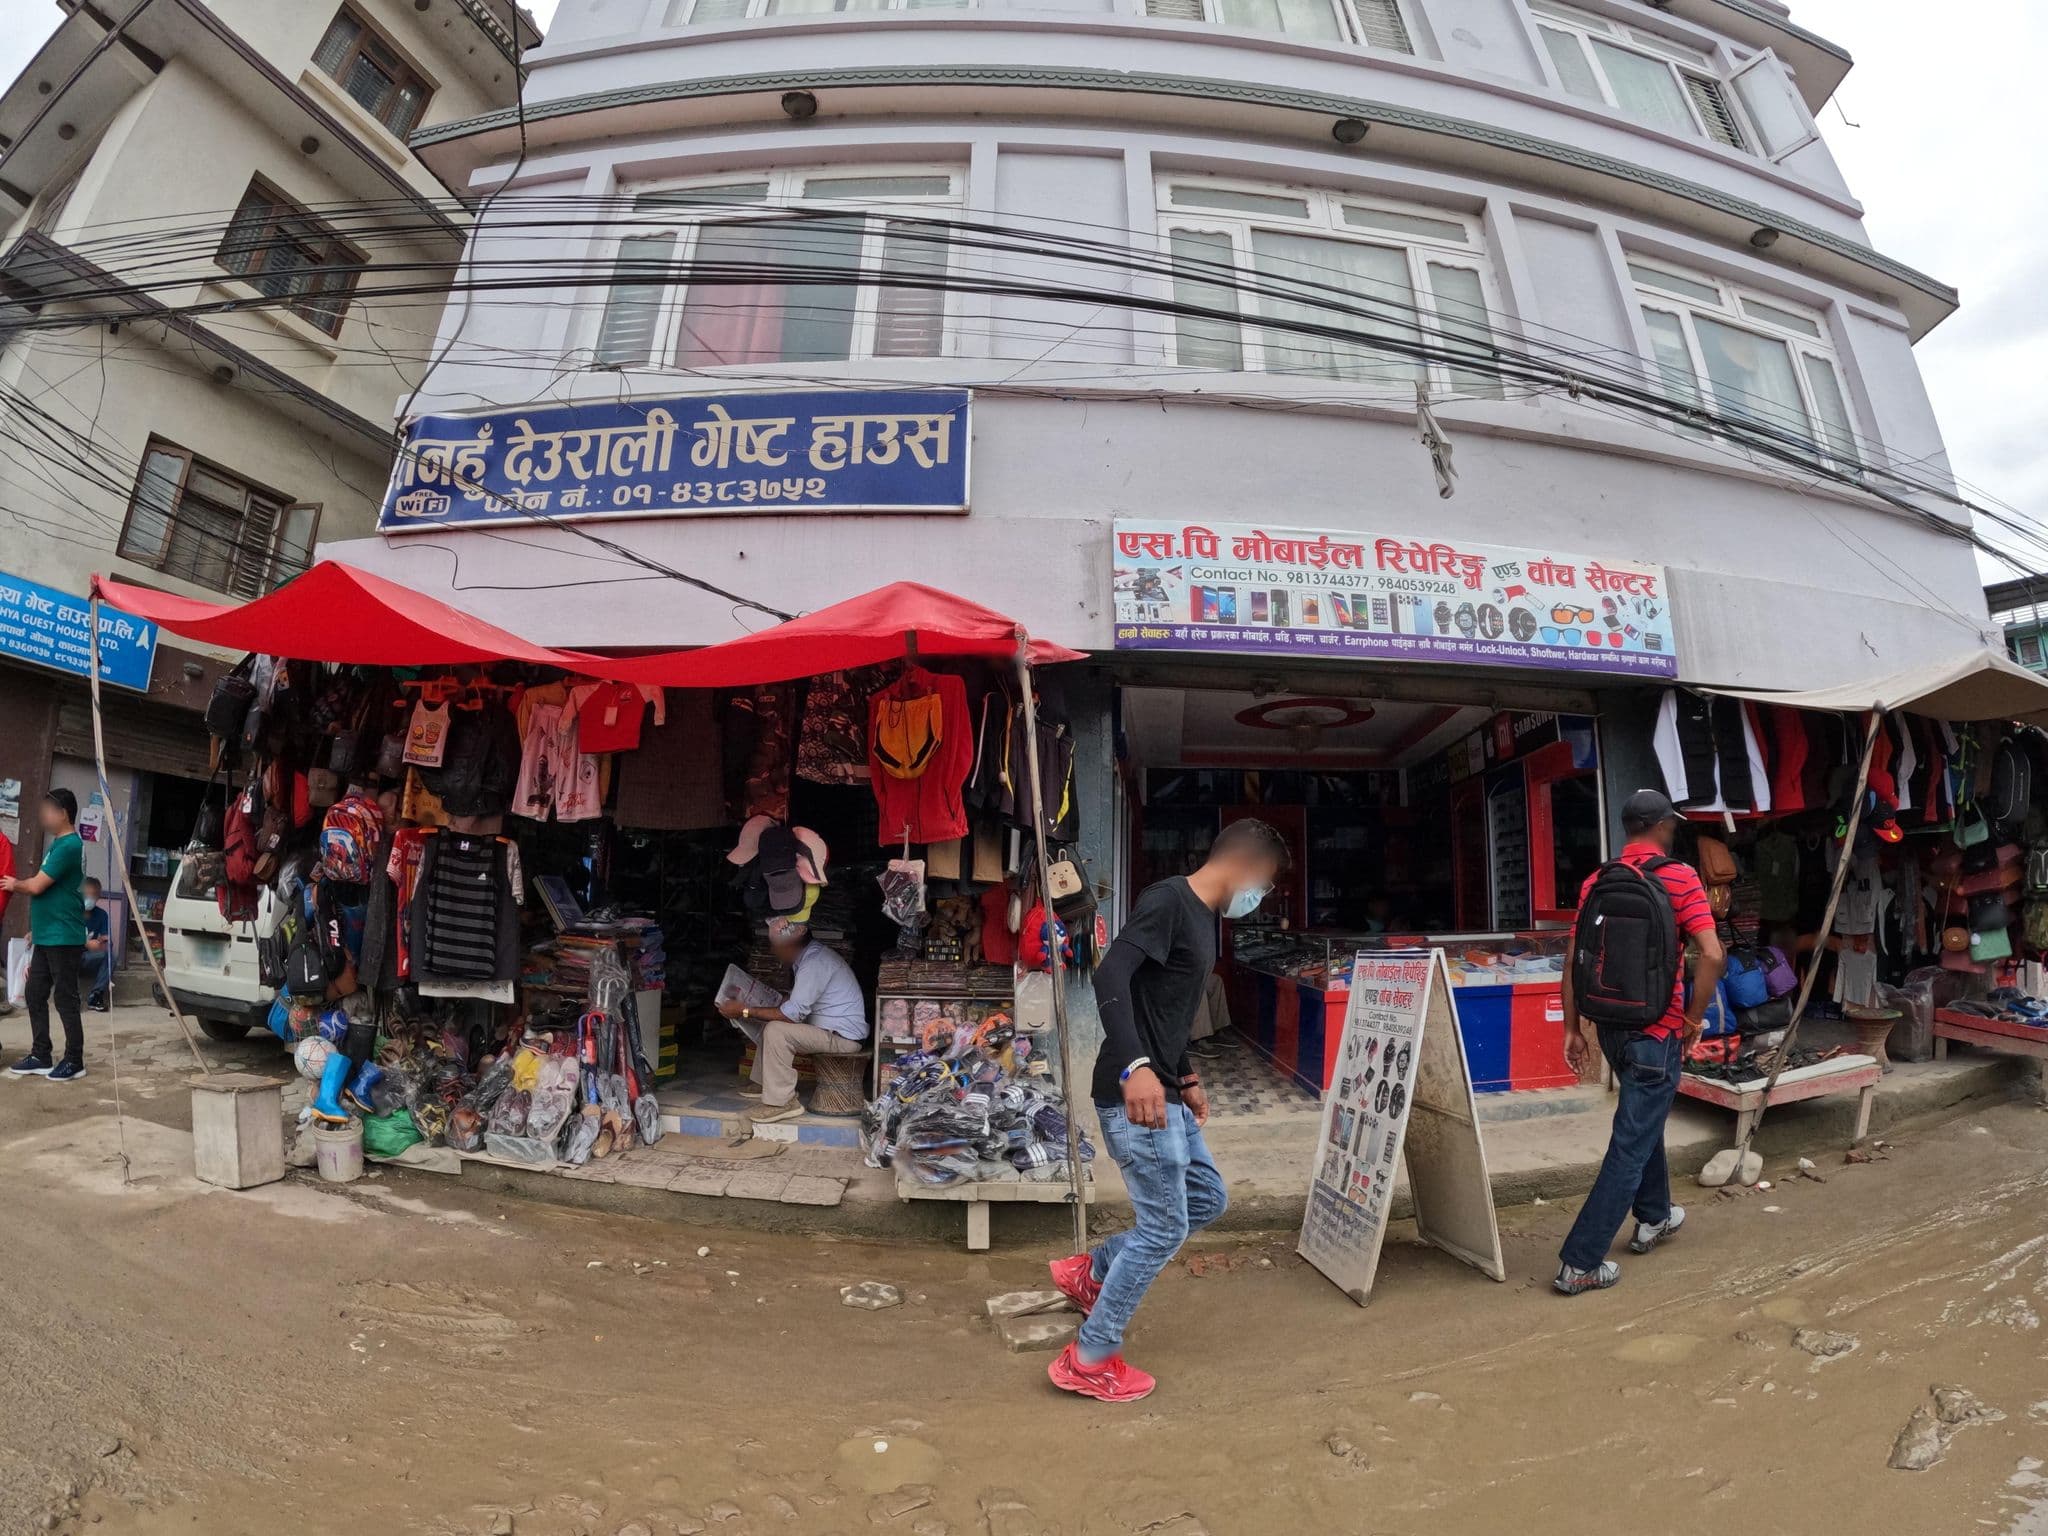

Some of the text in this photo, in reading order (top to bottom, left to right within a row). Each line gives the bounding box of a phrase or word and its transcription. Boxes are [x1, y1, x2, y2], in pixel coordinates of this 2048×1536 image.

[503, 408, 678, 485] देउराली
[691, 404, 796, 468] गेष्ट
[810, 412, 957, 472] हाउस
[1191, 567, 1253, 580] Contact
[1257, 570, 1282, 582] No.
[1378, 577, 1457, 594] 9840539248
[1232, 529, 1366, 570] मोबाईल
[1584, 561, 1658, 599] सेन्टर
[22, 613, 55, 631] GUEST
[55, 624, 90, 642] HOUSE
[100, 637, 120, 651] LTD.
[1345, 636, 1389, 648] Earrphone
